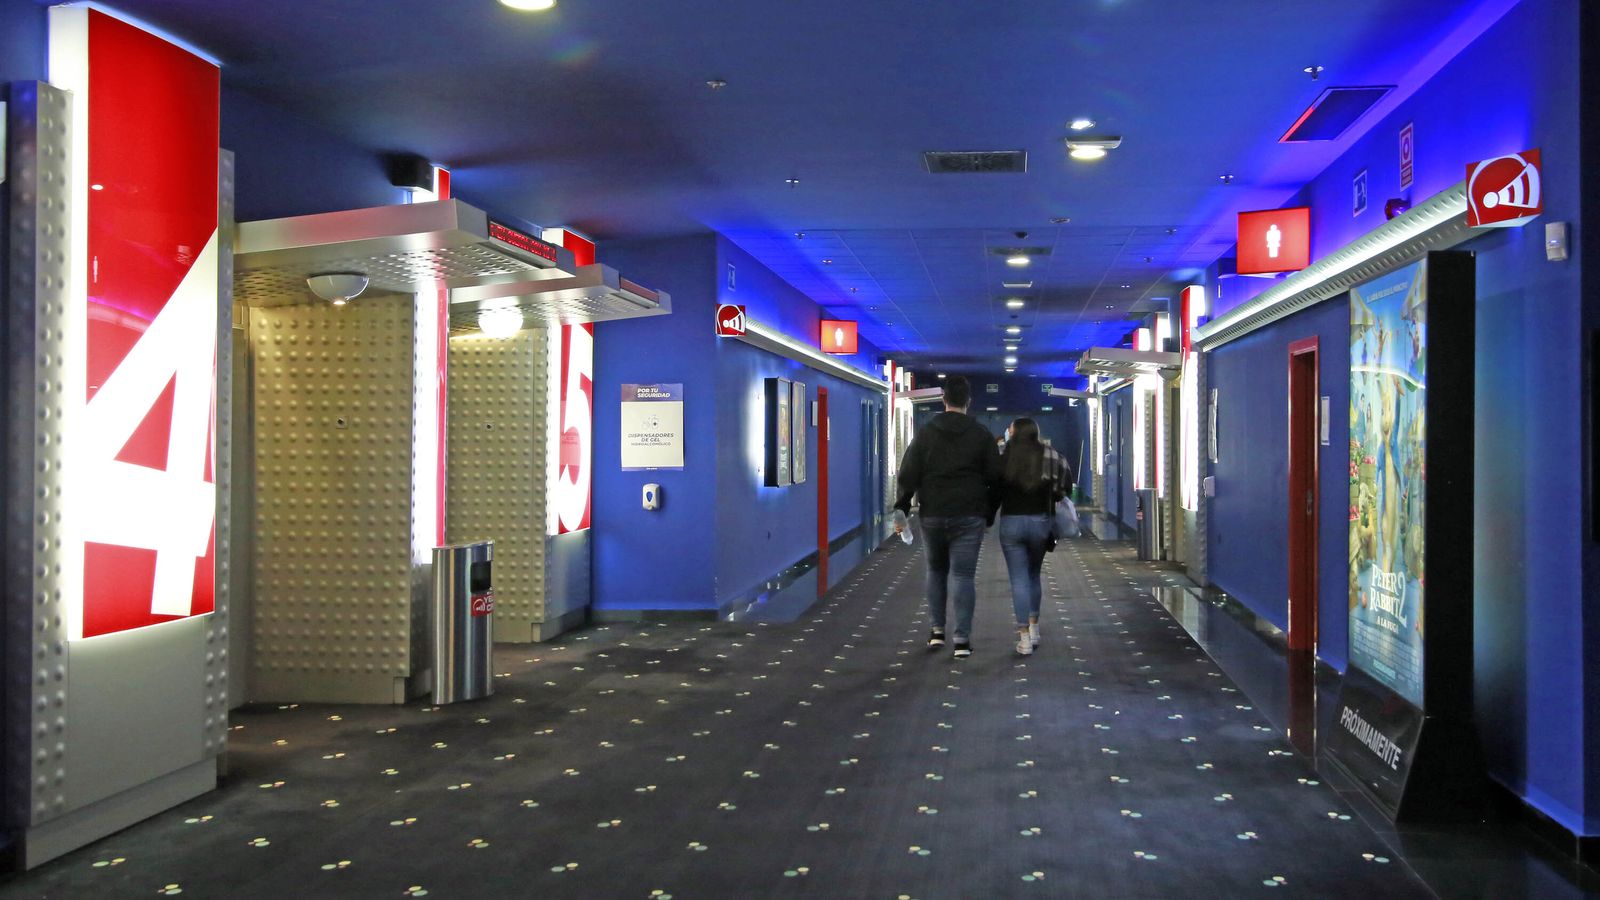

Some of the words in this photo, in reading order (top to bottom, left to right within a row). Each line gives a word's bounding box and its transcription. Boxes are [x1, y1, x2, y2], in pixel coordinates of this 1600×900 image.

[86, 227, 217, 617] 4
[558, 322, 594, 532] 5
[1370, 586, 1400, 620] RABBIT
[1397, 571, 1408, 628] 2
[1371, 563, 1399, 596] PETER
[1340, 706, 1402, 771] PRÓXIMAMENTE
